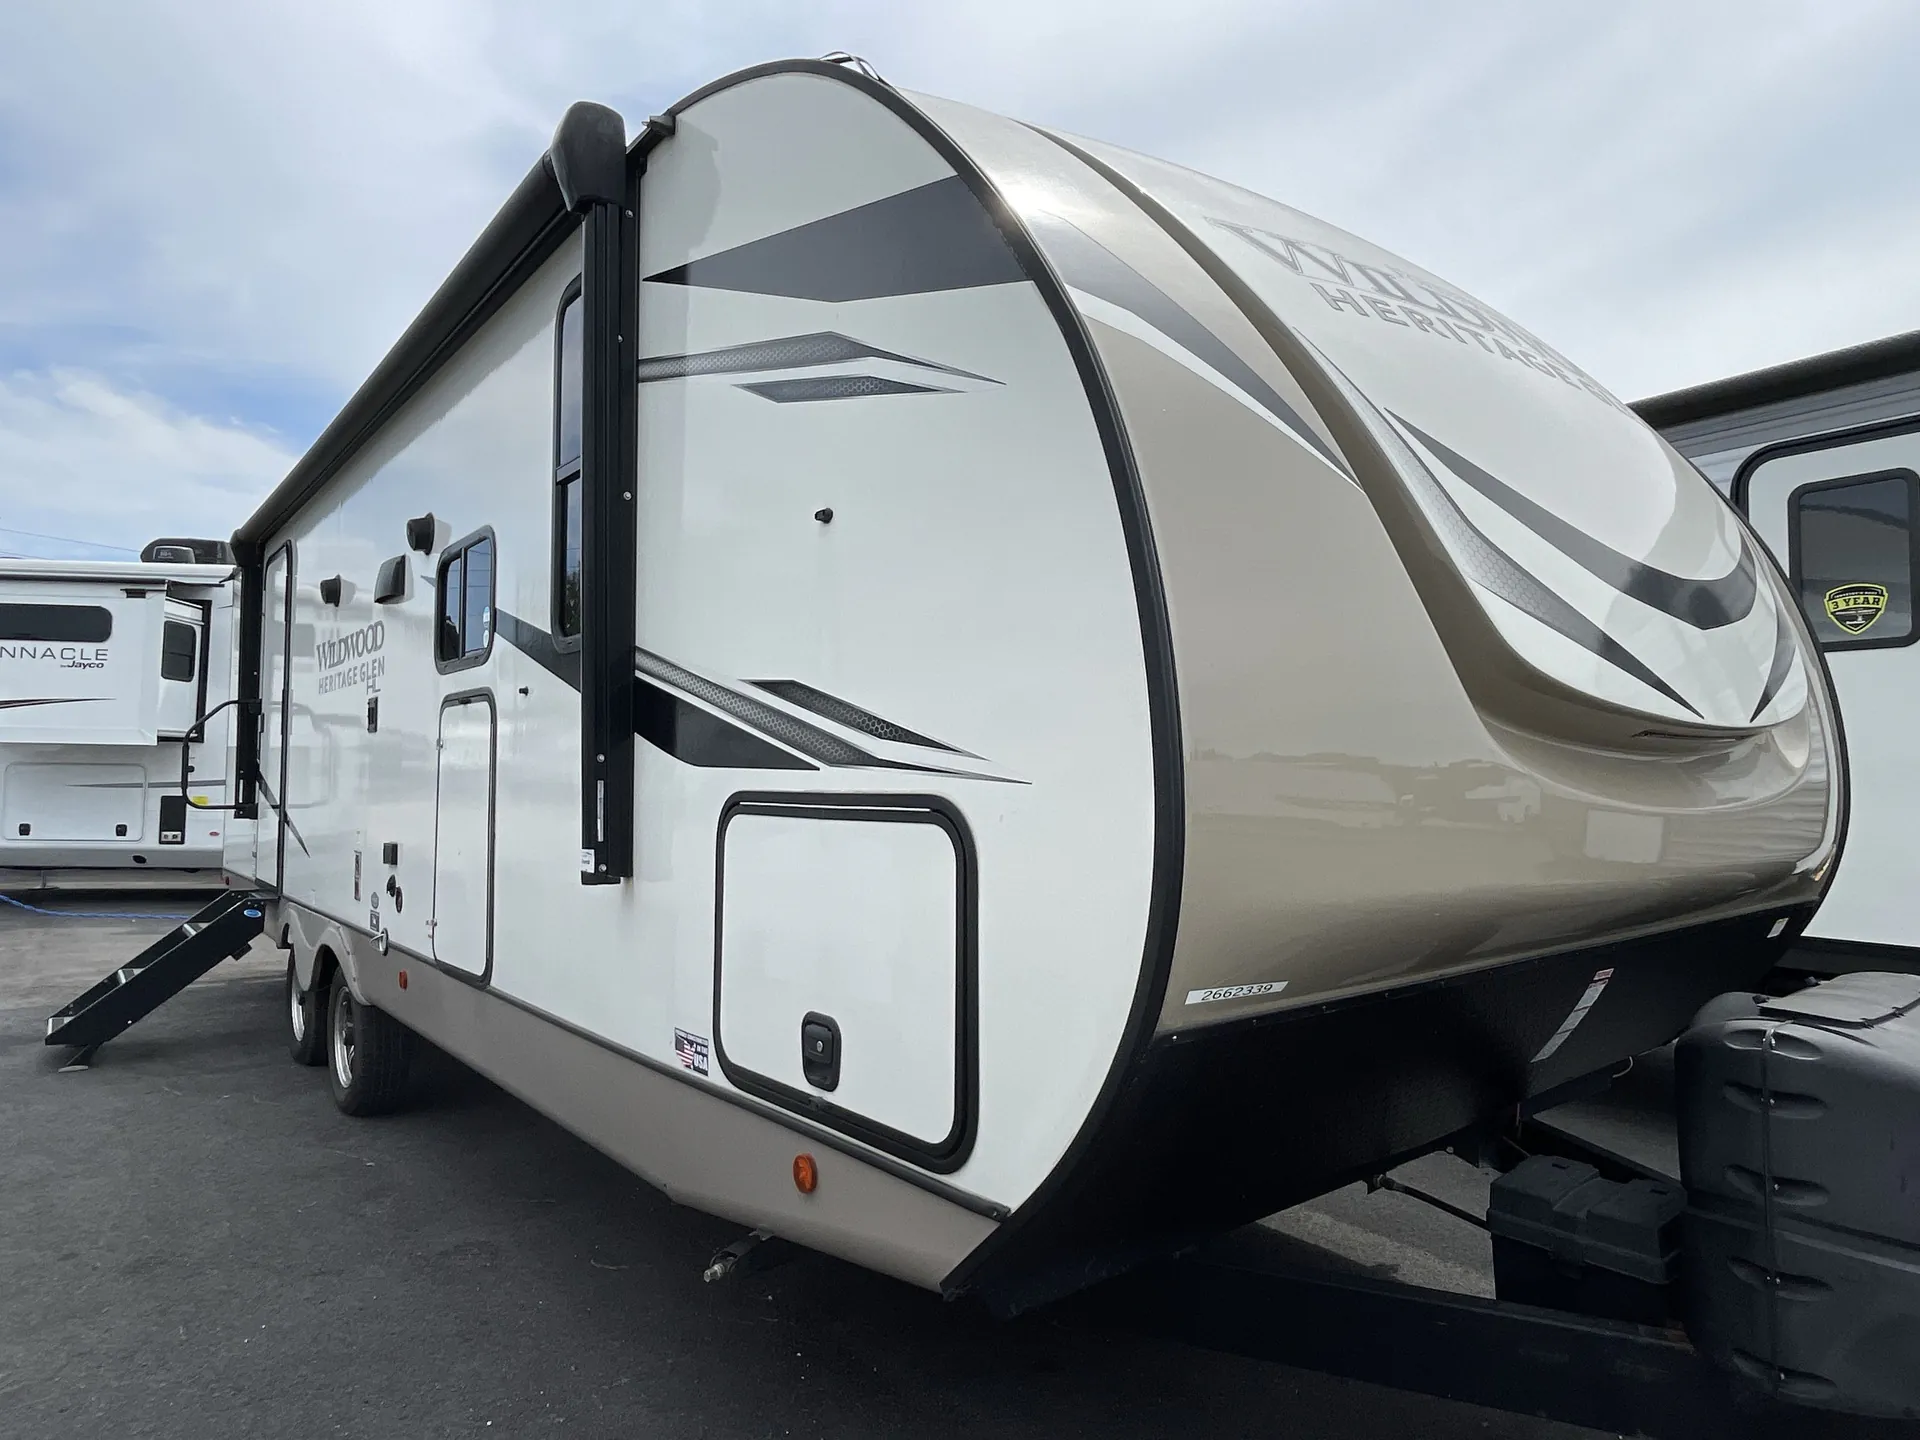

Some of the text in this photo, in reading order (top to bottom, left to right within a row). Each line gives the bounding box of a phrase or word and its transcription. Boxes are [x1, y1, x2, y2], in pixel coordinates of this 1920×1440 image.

[1310, 281, 1583, 391] HERITAGE
[1831, 596, 1881, 610] 3 YEAR
[0, 646, 108, 661] NNACLE
[316, 620, 385, 672] WILDWOOD
[68, 661, 104, 669] Jayco
[318, 655, 385, 695] HERITAGE GLEN
[1201, 984, 1273, 1001] 2662339
[694, 1053, 708, 1071] USA
